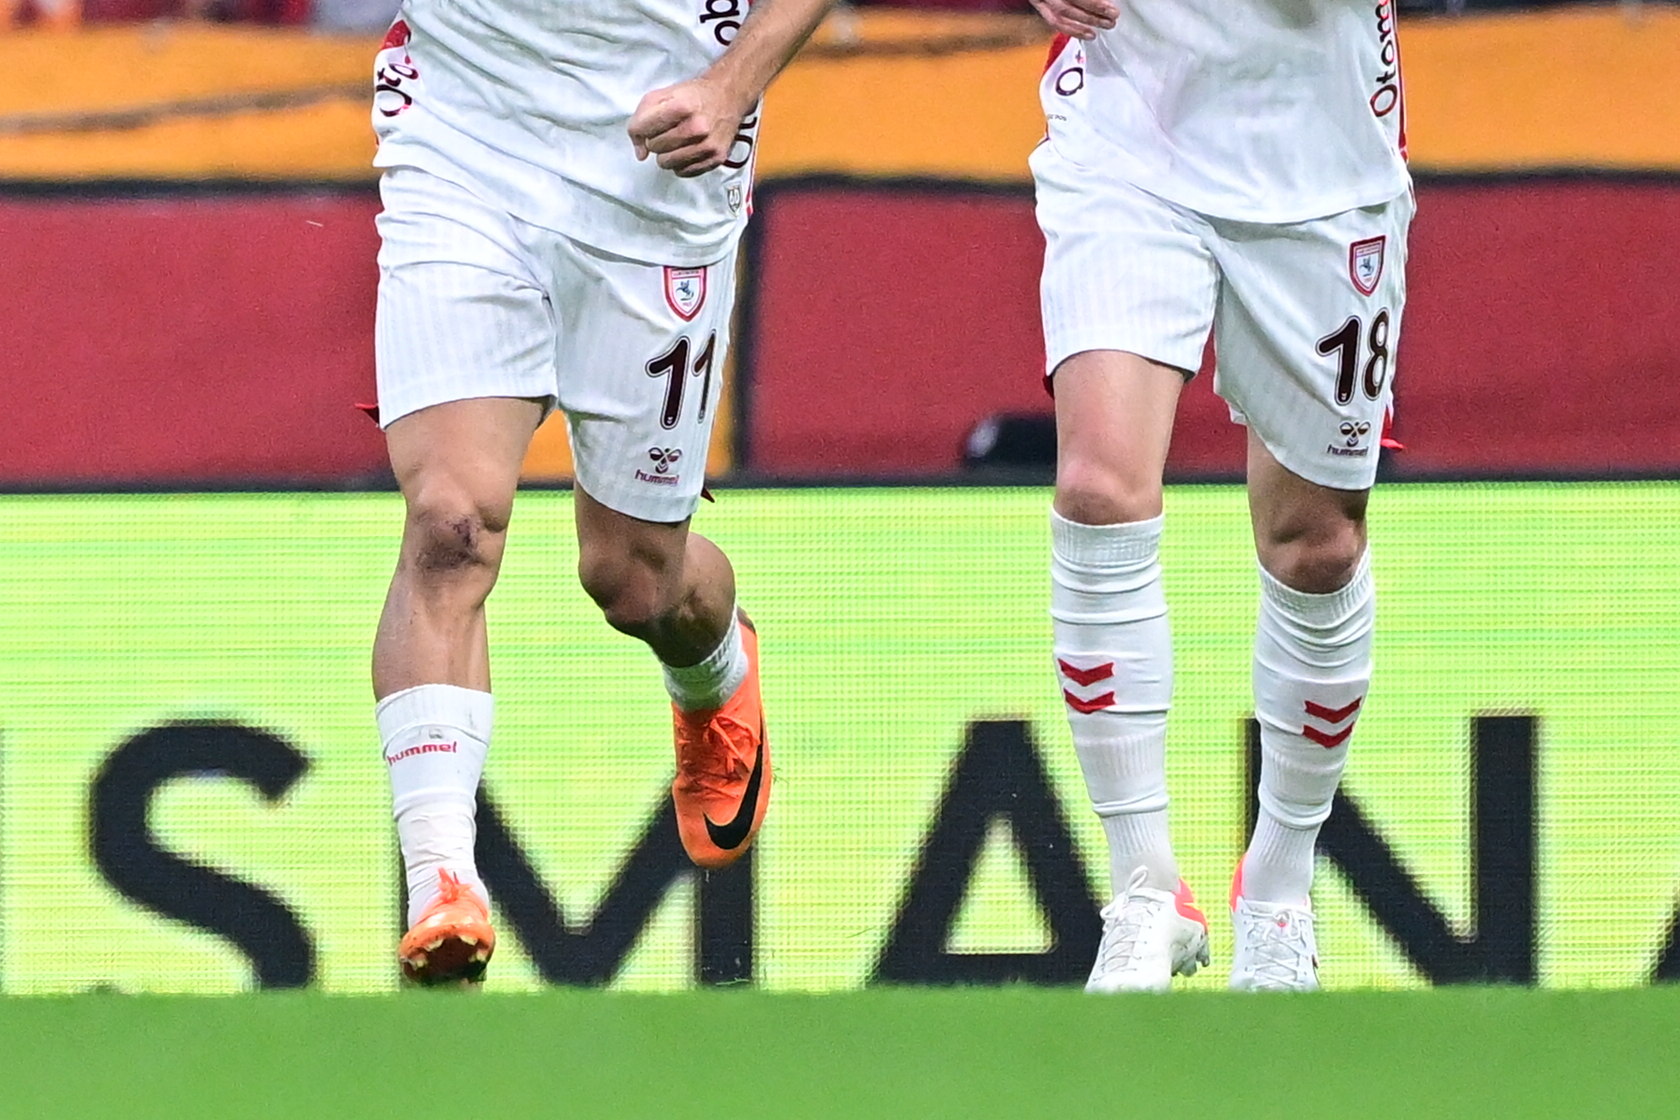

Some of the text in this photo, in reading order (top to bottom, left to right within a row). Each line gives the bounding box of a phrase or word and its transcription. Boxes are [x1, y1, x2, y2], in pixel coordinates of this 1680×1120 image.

[1315, 306, 1390, 406] 18
[645, 328, 717, 431] 11
[1326, 443, 1369, 459] hummel
[634, 468, 680, 486] hummel
[386, 740, 457, 767] hummel
